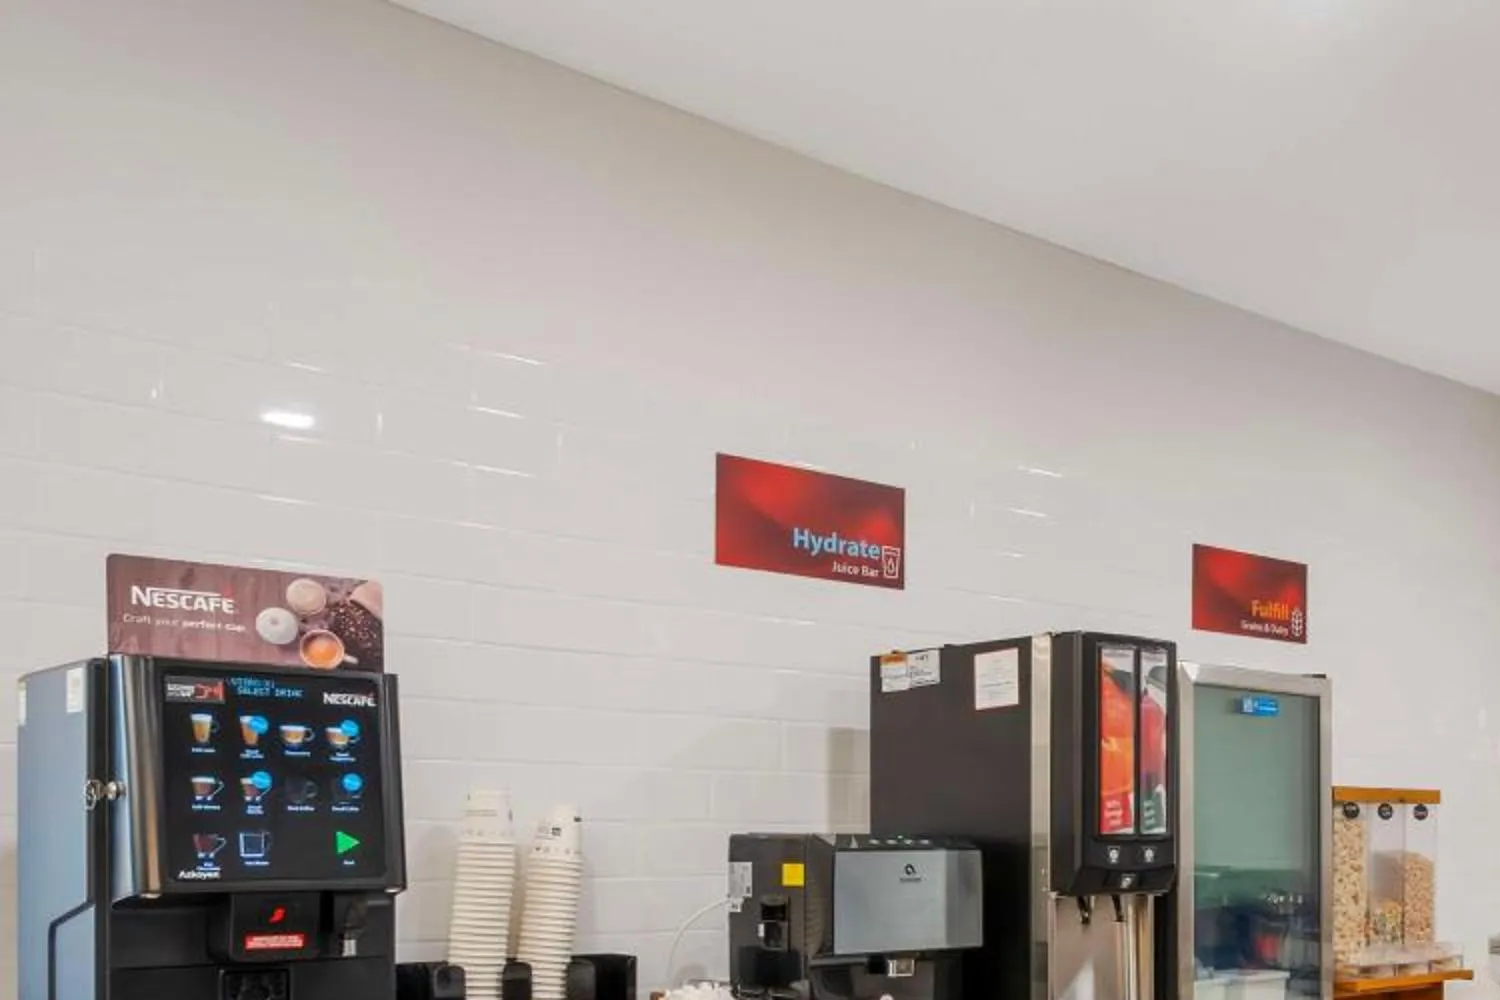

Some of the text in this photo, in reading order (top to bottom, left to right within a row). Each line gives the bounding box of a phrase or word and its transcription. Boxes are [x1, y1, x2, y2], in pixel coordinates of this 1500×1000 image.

[793, 527, 881, 560] Hydrate
[832, 560, 879, 577] Juice Bar
[1251, 599, 1289, 620] Fulfill
